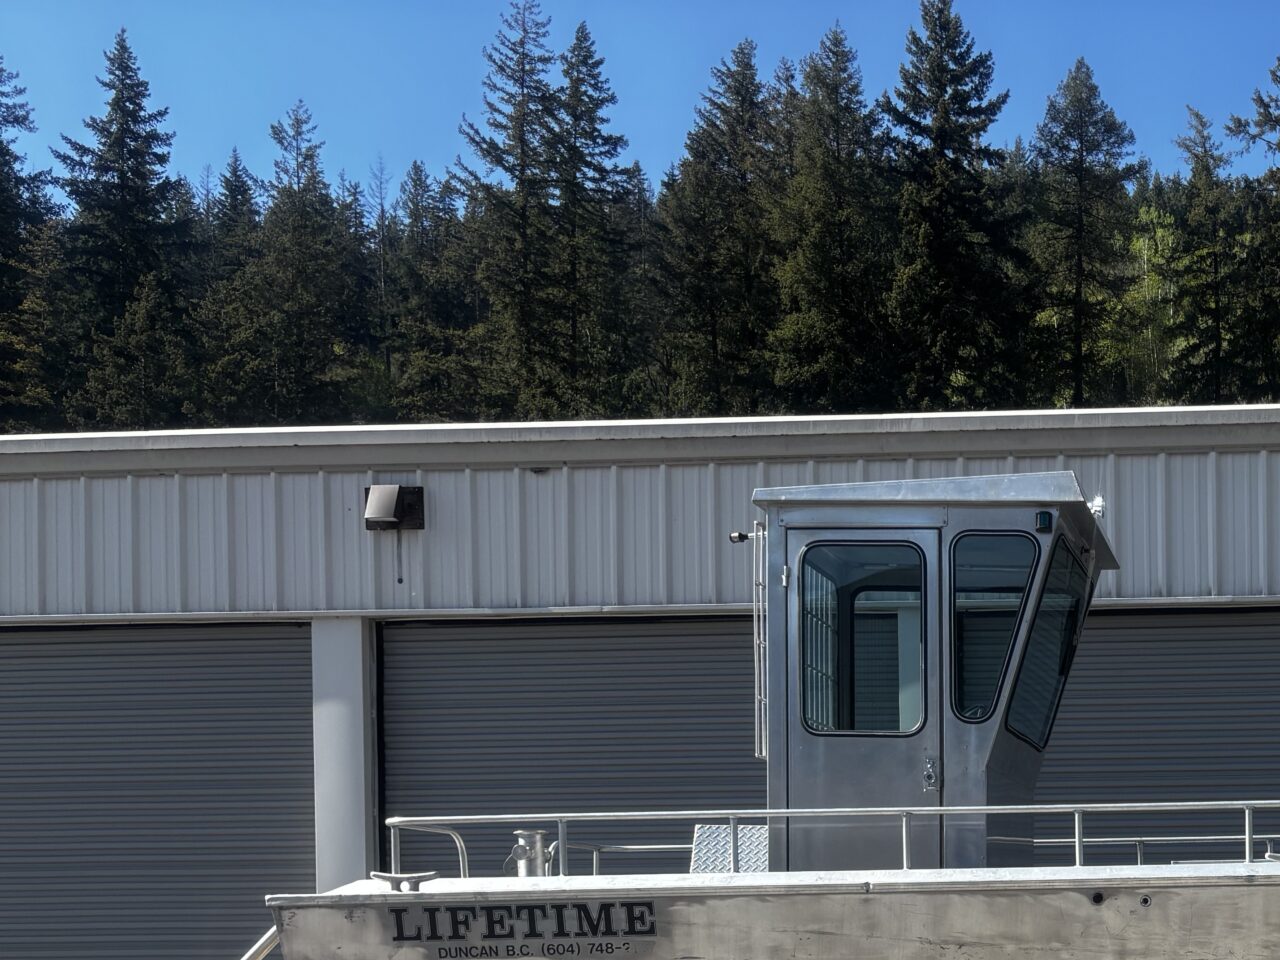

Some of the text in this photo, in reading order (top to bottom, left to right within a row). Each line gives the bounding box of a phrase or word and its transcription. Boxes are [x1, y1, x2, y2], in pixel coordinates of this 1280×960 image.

[388, 901, 657, 941] LIFETIME
[438, 946, 499, 959] DUNCAN
[506, 945, 534, 957] B.C.
[541, 943, 581, 956] (604)
